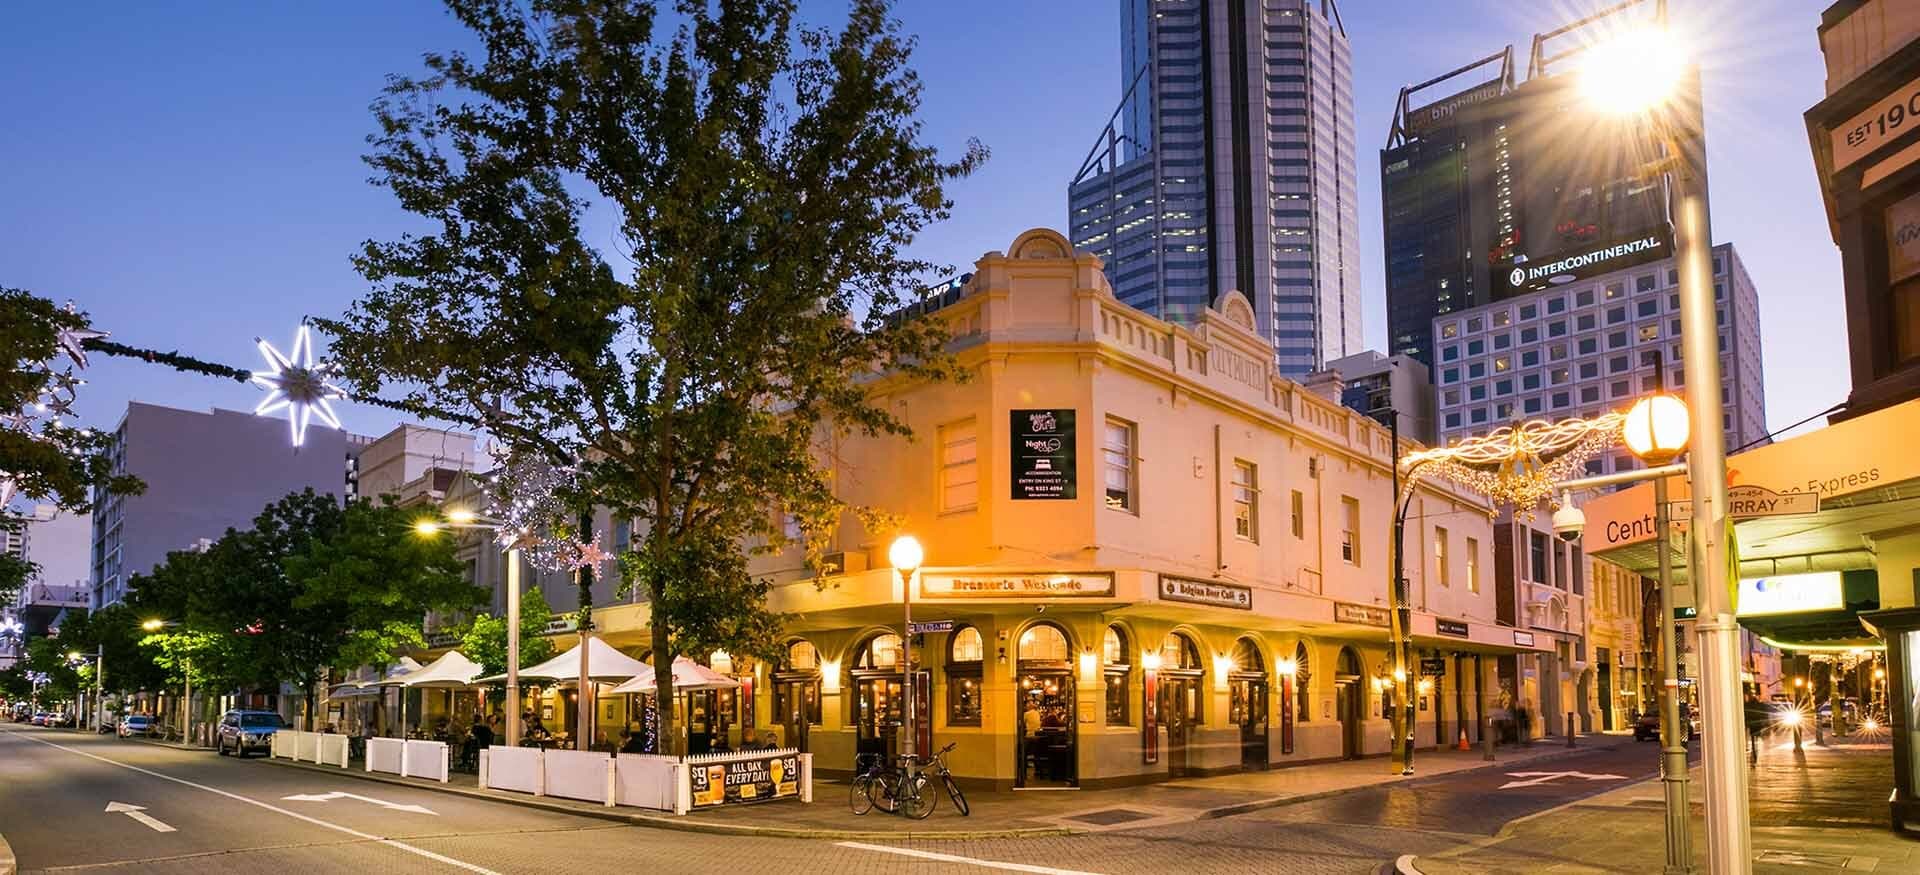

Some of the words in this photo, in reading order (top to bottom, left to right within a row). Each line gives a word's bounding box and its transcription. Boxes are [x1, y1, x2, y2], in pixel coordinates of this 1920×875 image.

[1847, 120, 1873, 145] EST
[1025, 440, 1047, 450] Night
[1808, 468, 1880, 494] Express
[732, 763, 746, 773] ALL
[726, 772, 752, 785] EVERY
